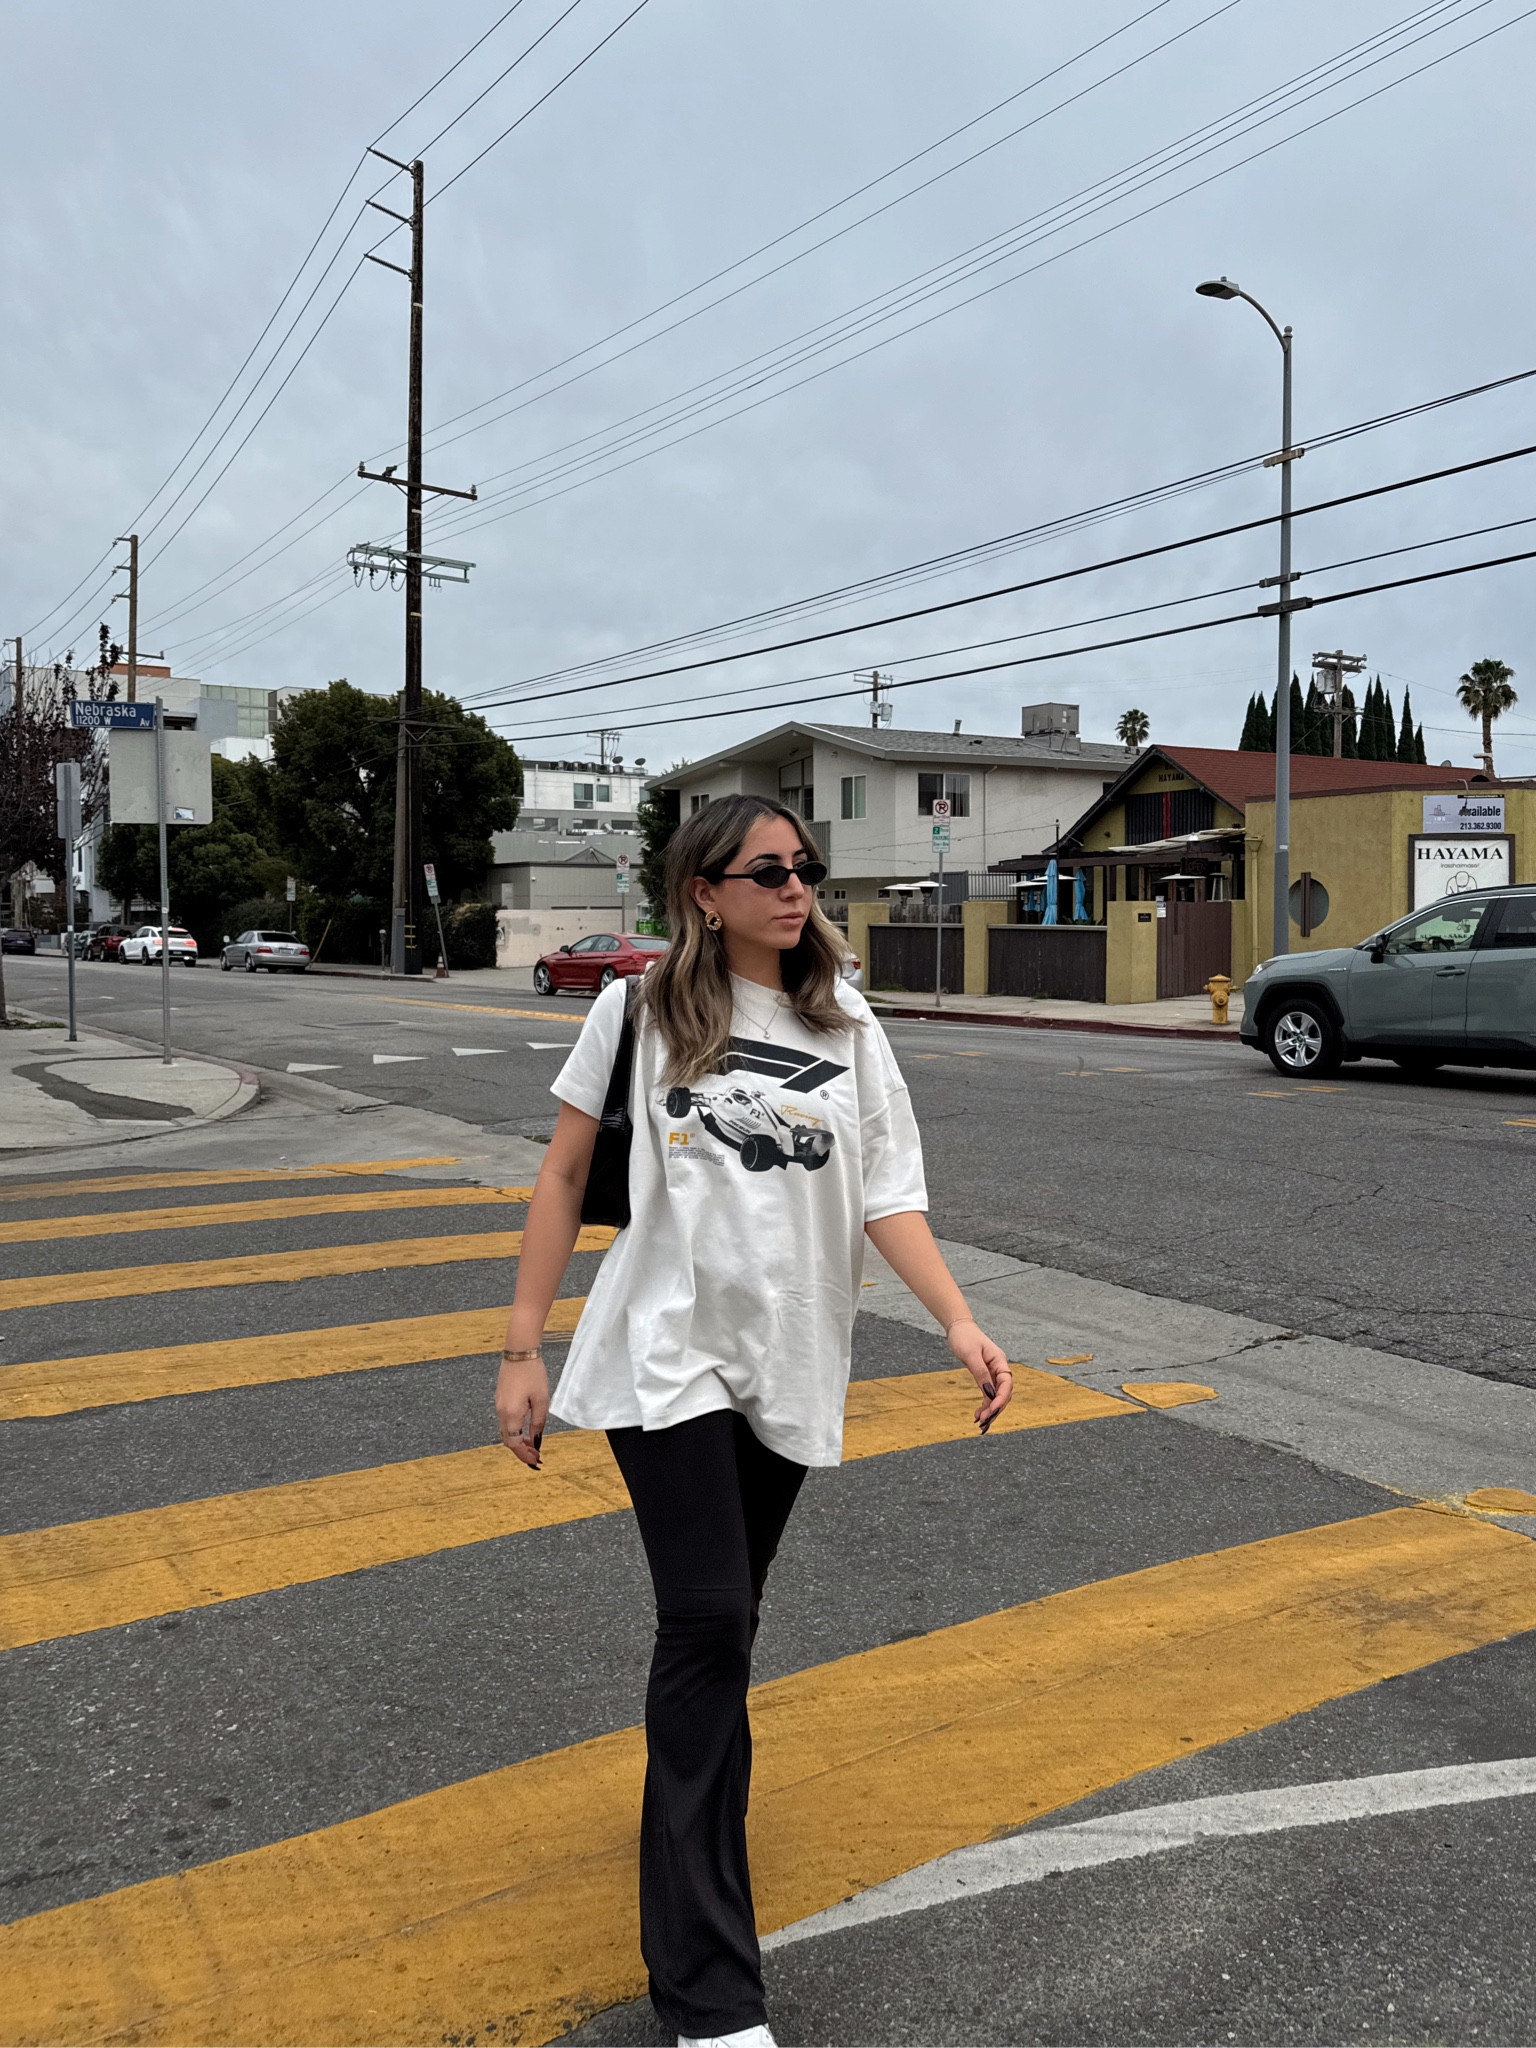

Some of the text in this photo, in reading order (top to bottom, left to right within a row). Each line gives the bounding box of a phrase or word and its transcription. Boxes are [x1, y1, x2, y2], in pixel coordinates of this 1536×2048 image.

[75, 702, 137, 718] Nebraska
[75, 715, 150, 727] 11200 W Av
[1417, 847, 1504, 860] HAYAMA
[749, 1108, 762, 1120] F1
[668, 1132, 689, 1146] F1
